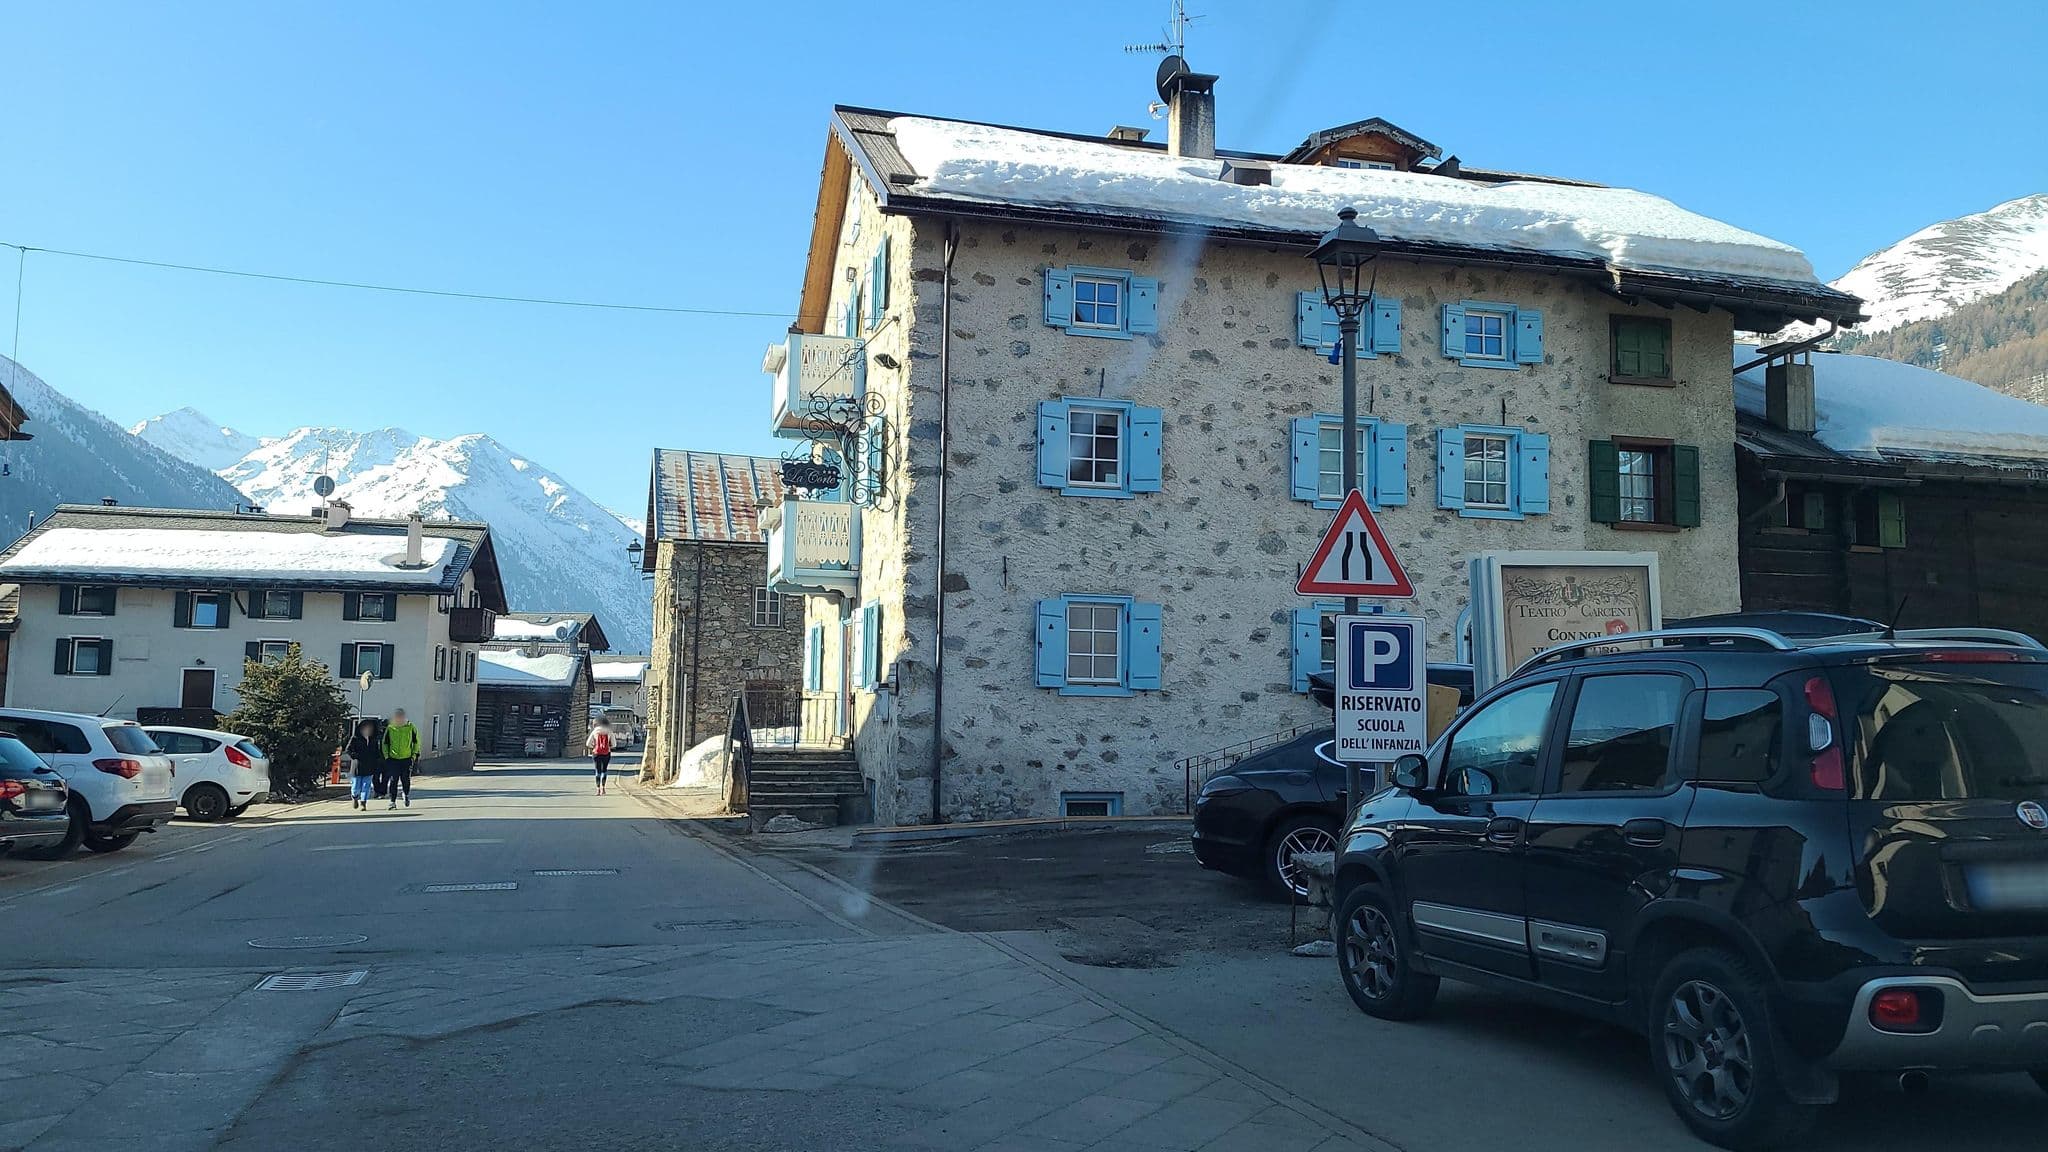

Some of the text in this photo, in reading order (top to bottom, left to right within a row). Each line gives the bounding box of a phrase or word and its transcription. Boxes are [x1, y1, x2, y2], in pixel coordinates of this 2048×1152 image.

[785, 467, 836, 483] La Corte
[1515, 604, 1567, 618] TEATRO
[1547, 628, 1576, 641] CON
[1362, 630, 1401, 683] P
[1341, 695, 1422, 712] RISERVATO
[1357, 719, 1406, 732] SCUOLA
